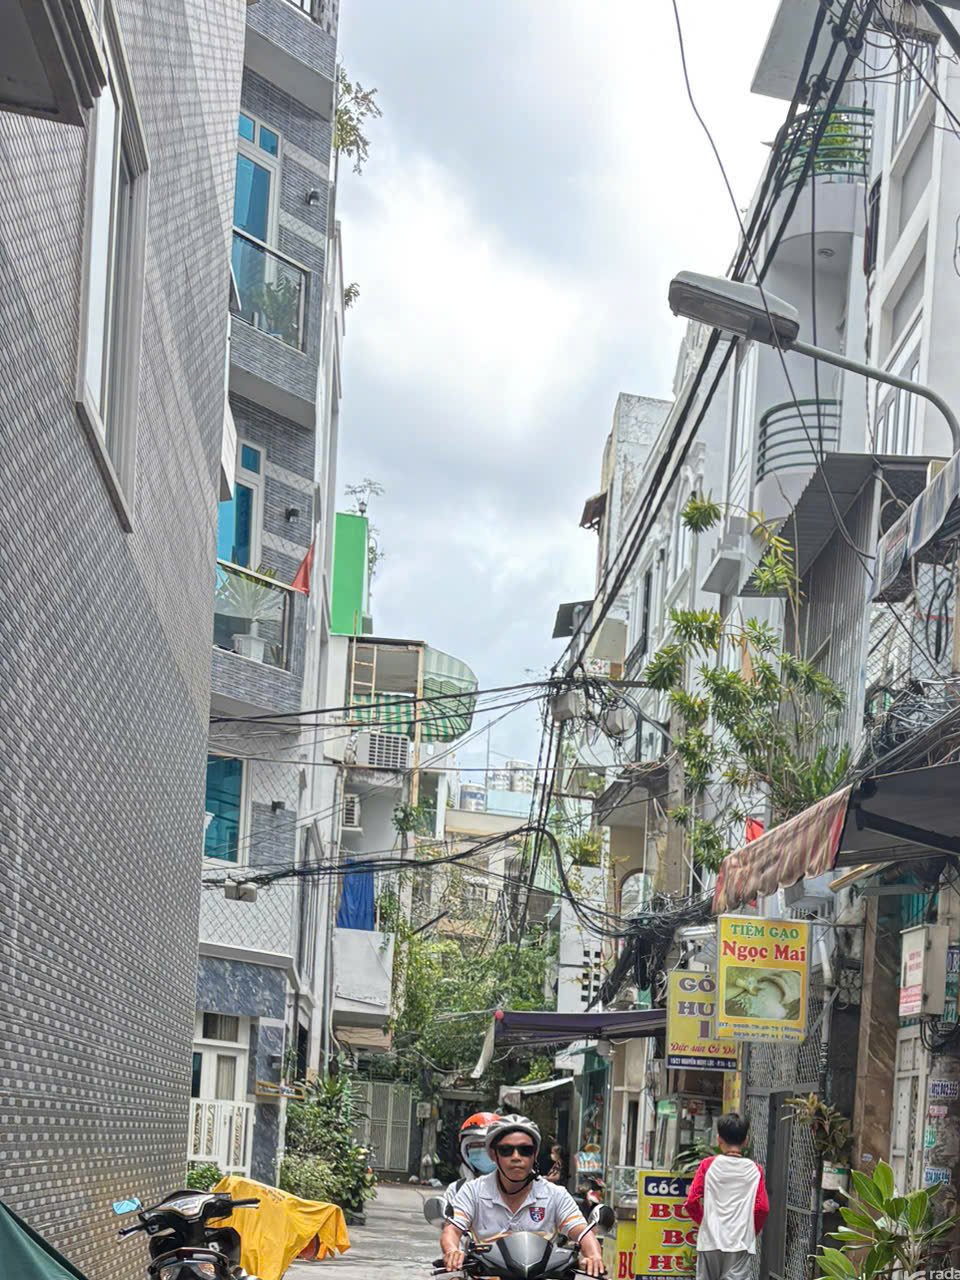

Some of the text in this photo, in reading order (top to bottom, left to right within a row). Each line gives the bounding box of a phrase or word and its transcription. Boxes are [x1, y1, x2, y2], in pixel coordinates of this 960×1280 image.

[730, 922, 800, 942] TIỆM GẠO
[721, 940, 806, 963] Ngọc Mai
[678, 974, 716, 993] GÓ
[677, 1000, 716, 1016] HU
[647, 1180, 680, 1195] GÓC
